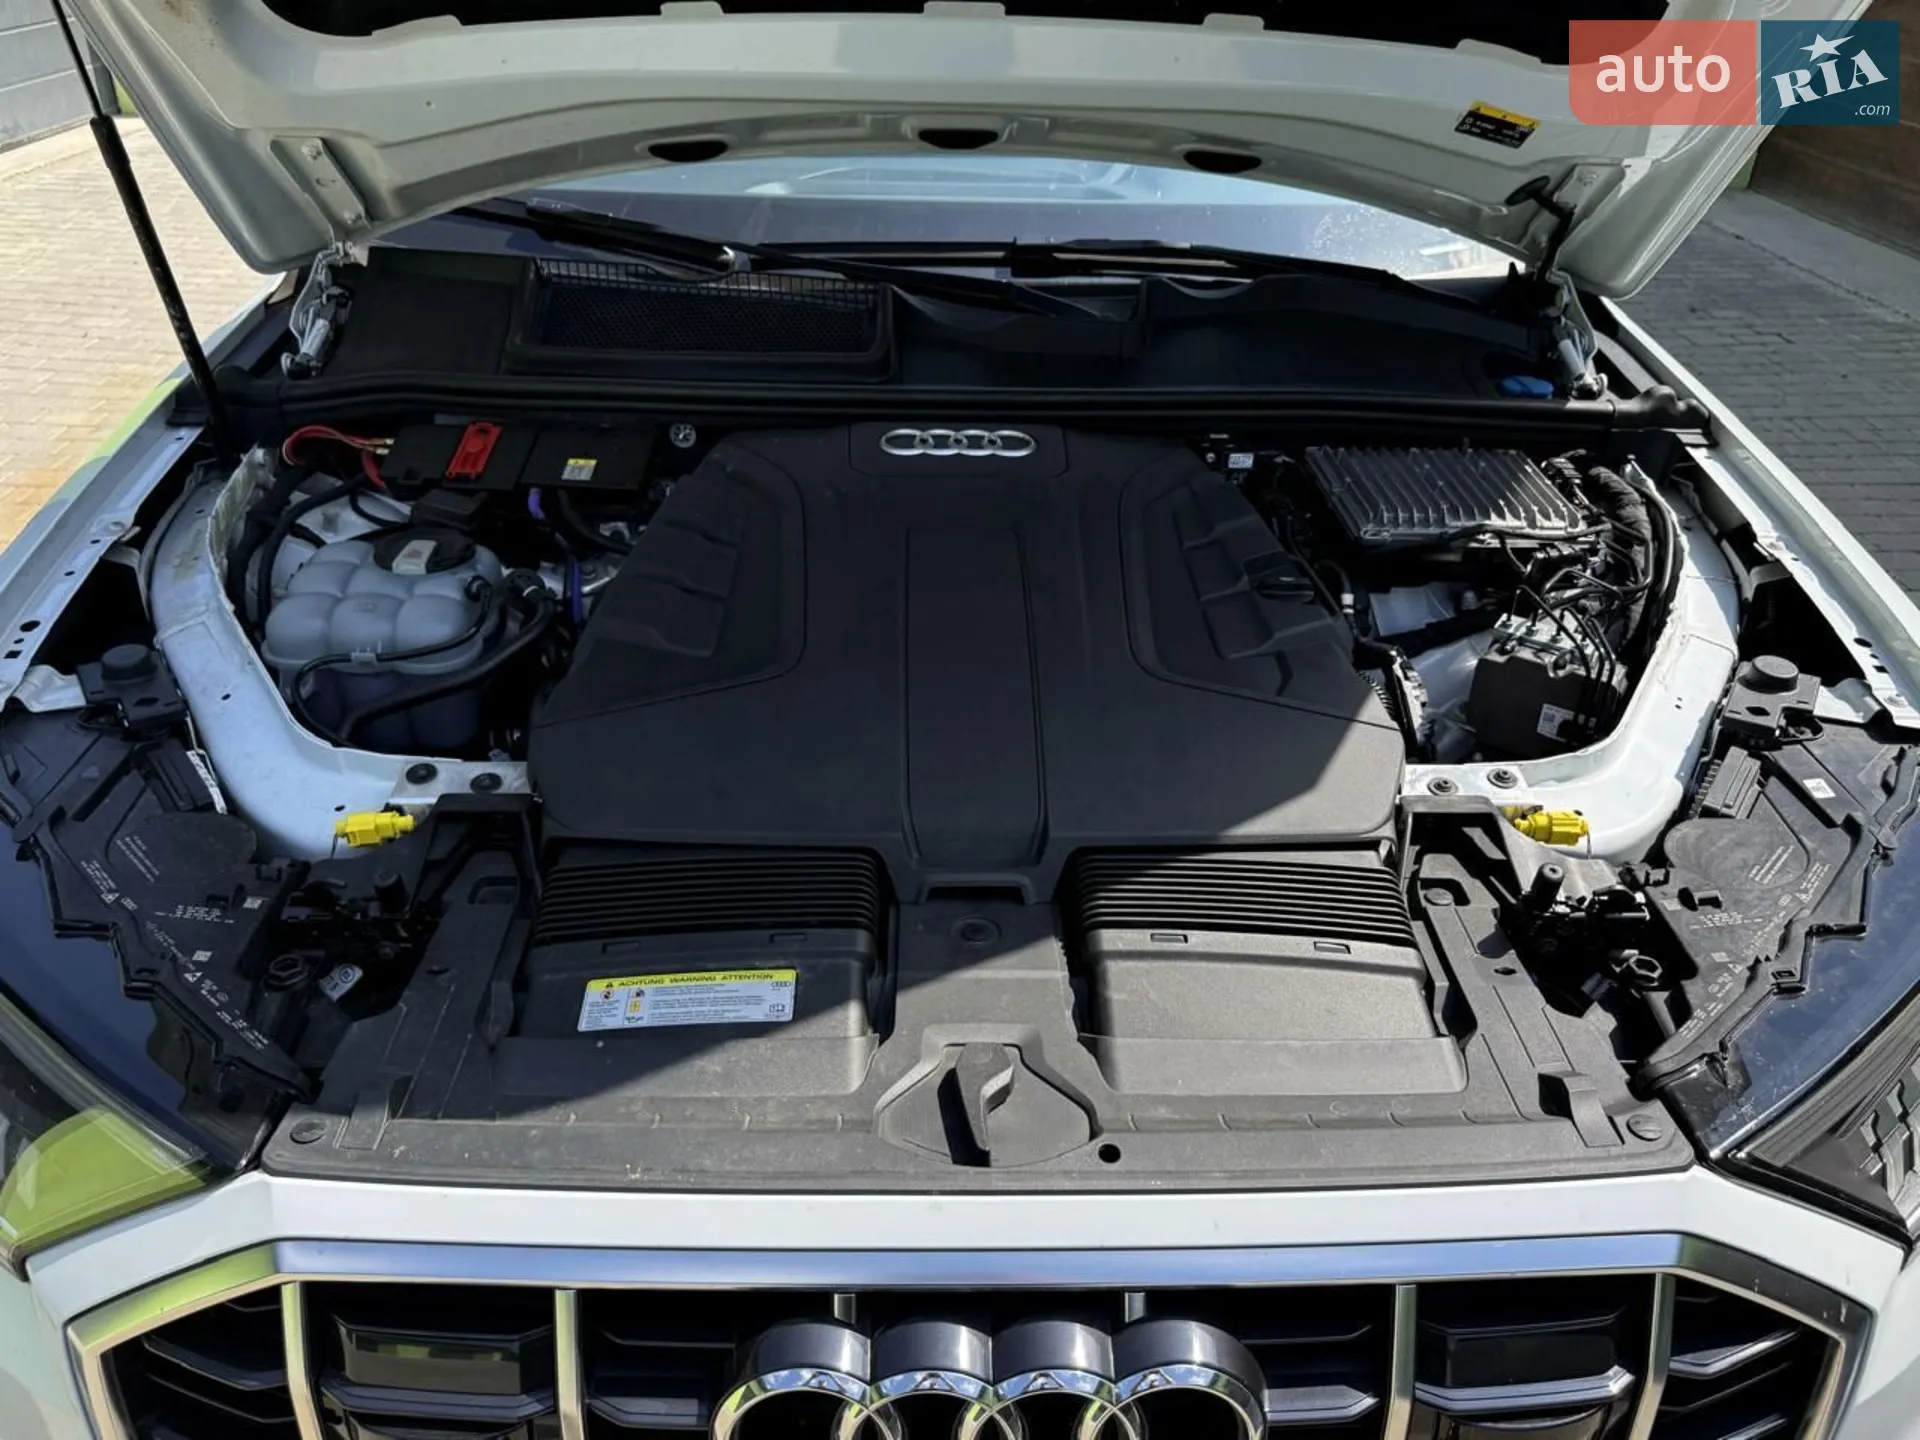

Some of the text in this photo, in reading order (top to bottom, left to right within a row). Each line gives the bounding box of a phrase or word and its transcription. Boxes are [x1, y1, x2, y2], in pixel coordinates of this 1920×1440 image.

[618, 973, 774, 987] ACHTUNG WARNING ATTENTION
